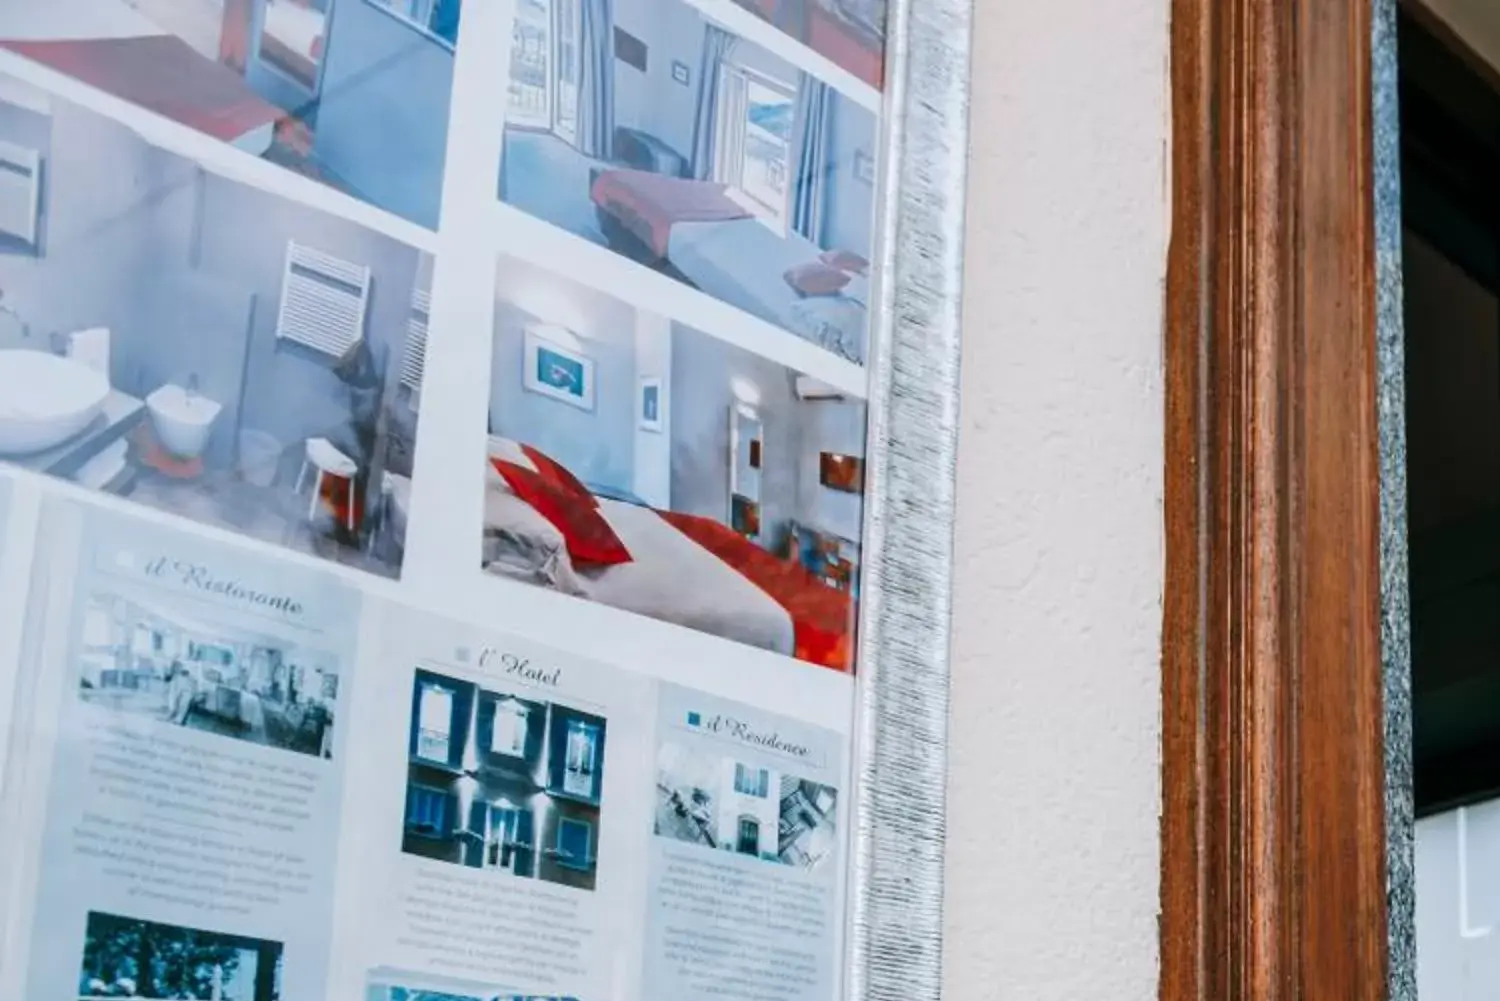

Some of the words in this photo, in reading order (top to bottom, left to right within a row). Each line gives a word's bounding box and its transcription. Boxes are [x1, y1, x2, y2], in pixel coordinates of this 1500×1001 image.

[173, 560, 303, 615] Ristorante
[501, 653, 561, 686] Hotel
[725, 718, 811, 756] Residence
